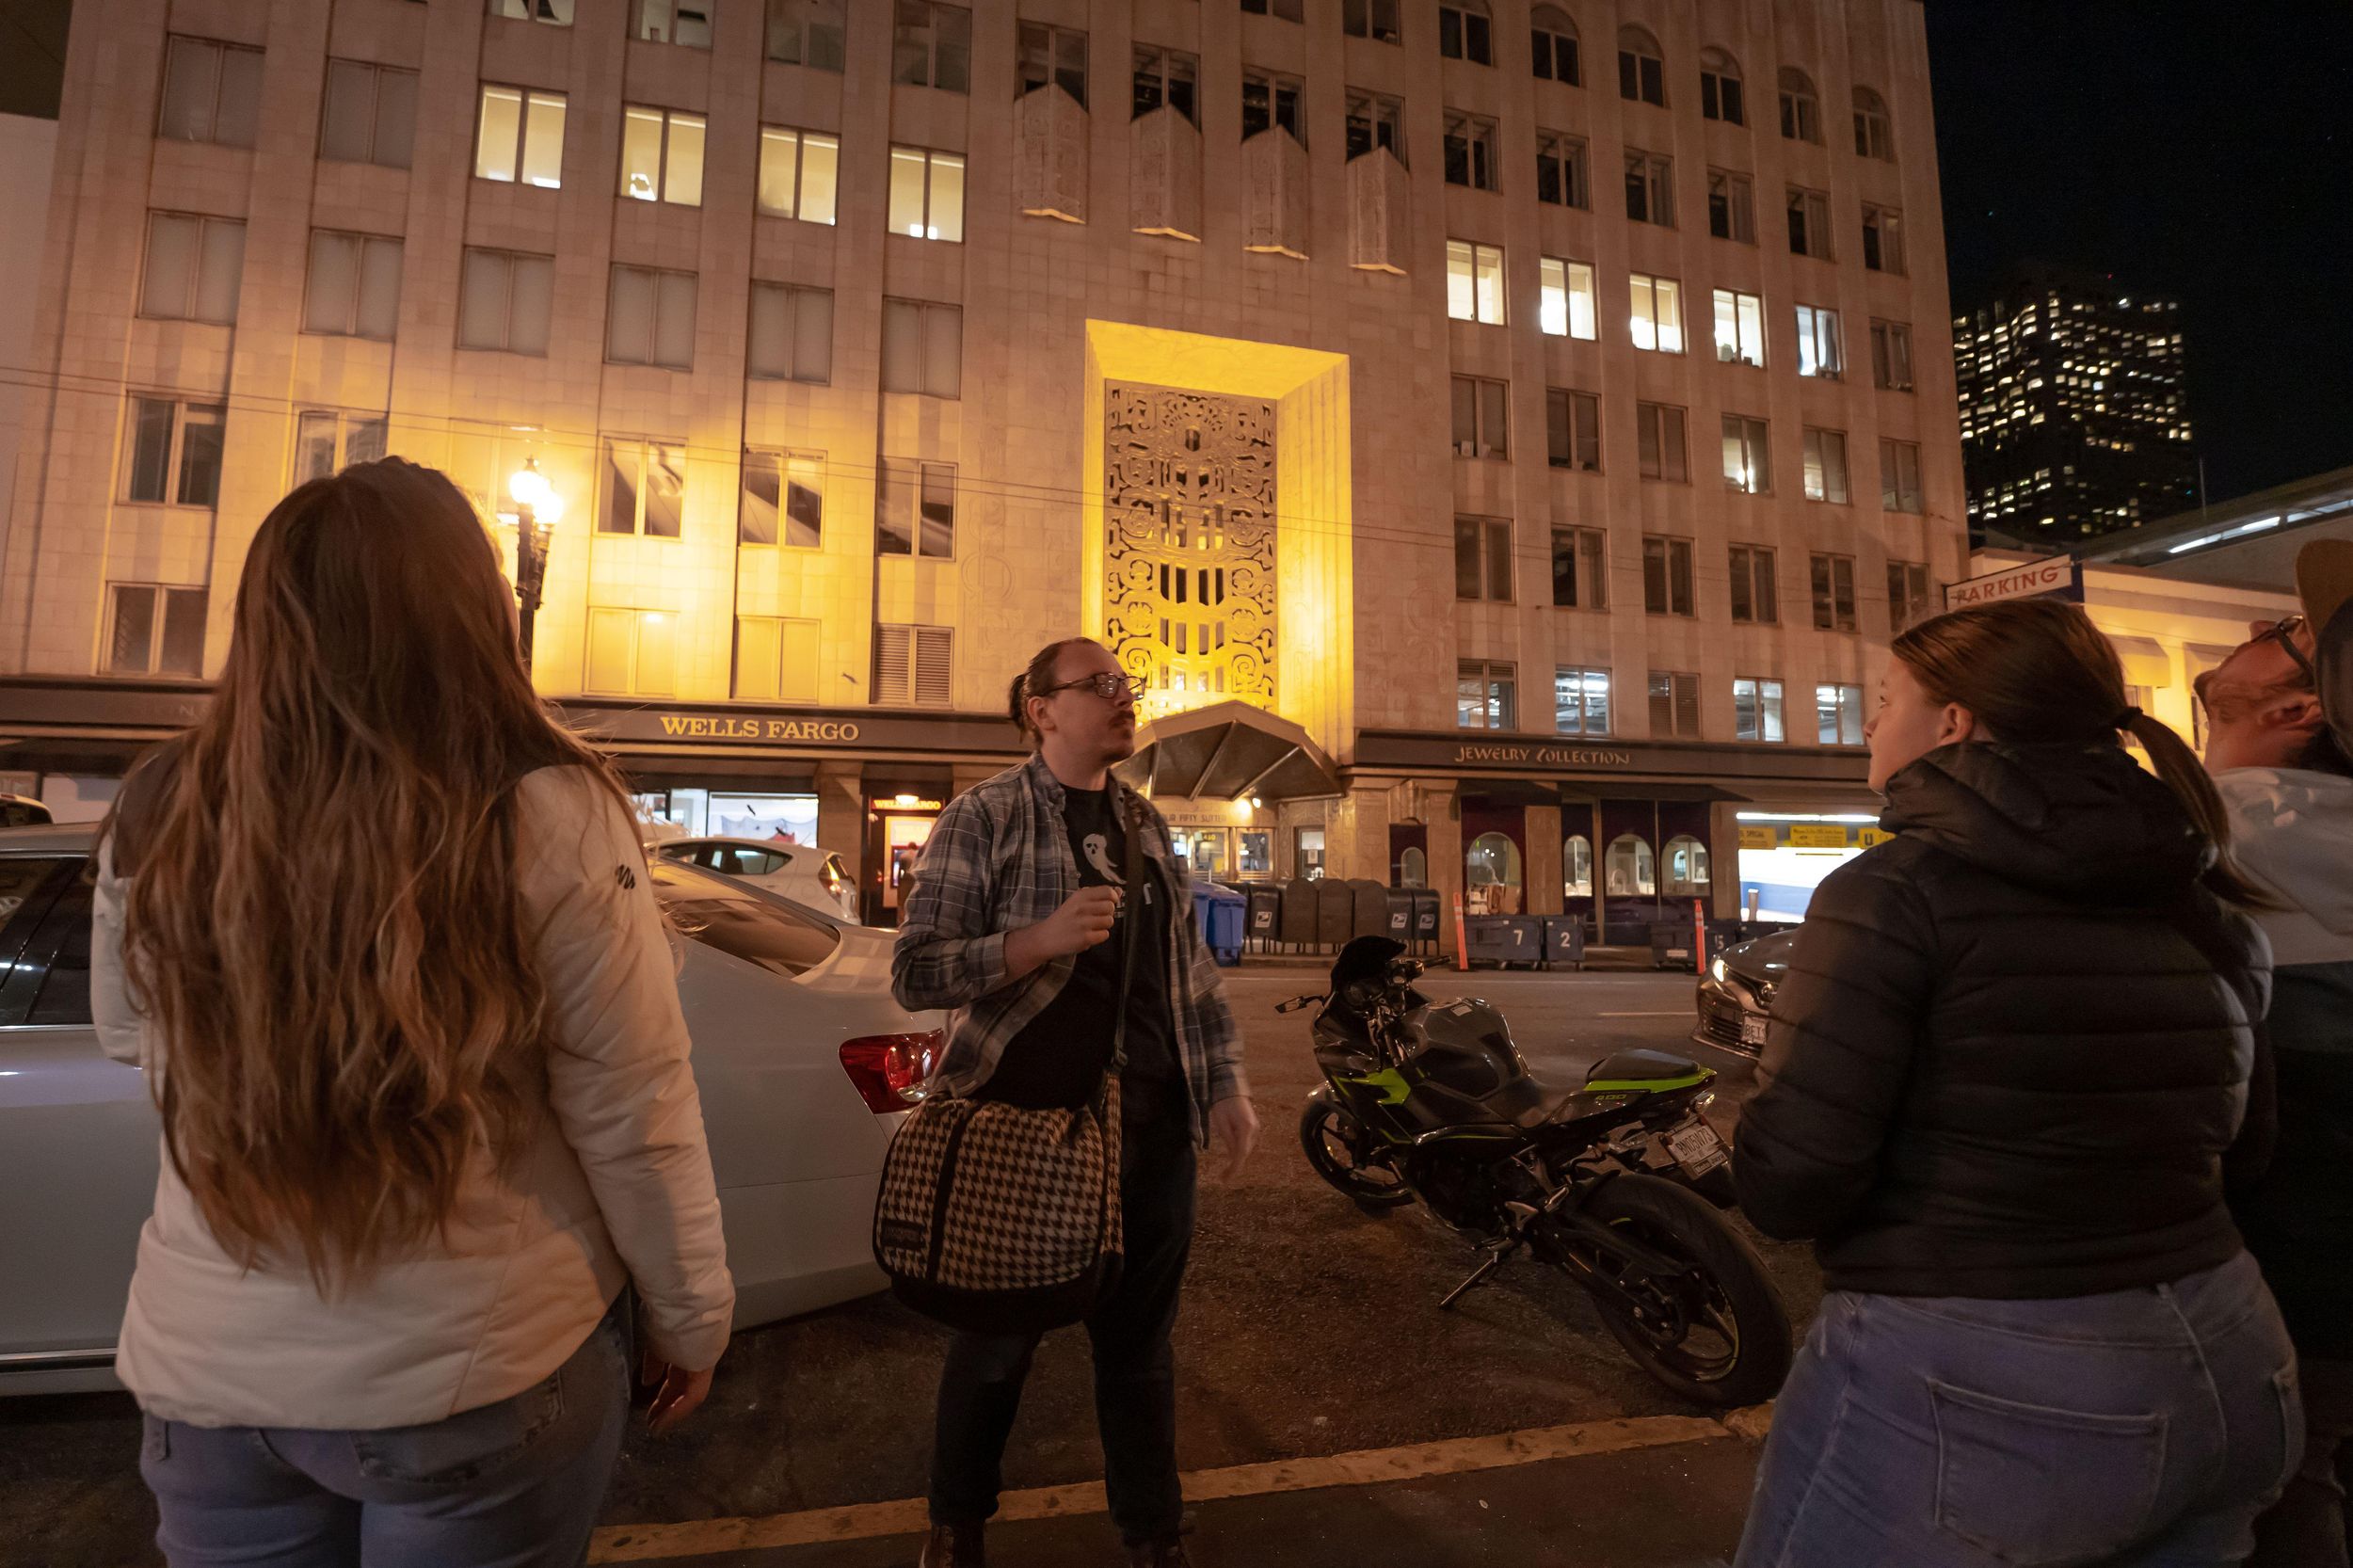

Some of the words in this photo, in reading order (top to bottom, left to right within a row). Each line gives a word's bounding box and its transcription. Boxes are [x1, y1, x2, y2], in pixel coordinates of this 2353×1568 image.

[660, 716, 760, 738] WELLS
[766, 720, 859, 742] FARGO
[1454, 745, 1530, 763] JEWELRY
[1536, 747, 1630, 765] COLLECTION
[1513, 930, 1524, 946] 7
[1560, 932, 1571, 948] 2
